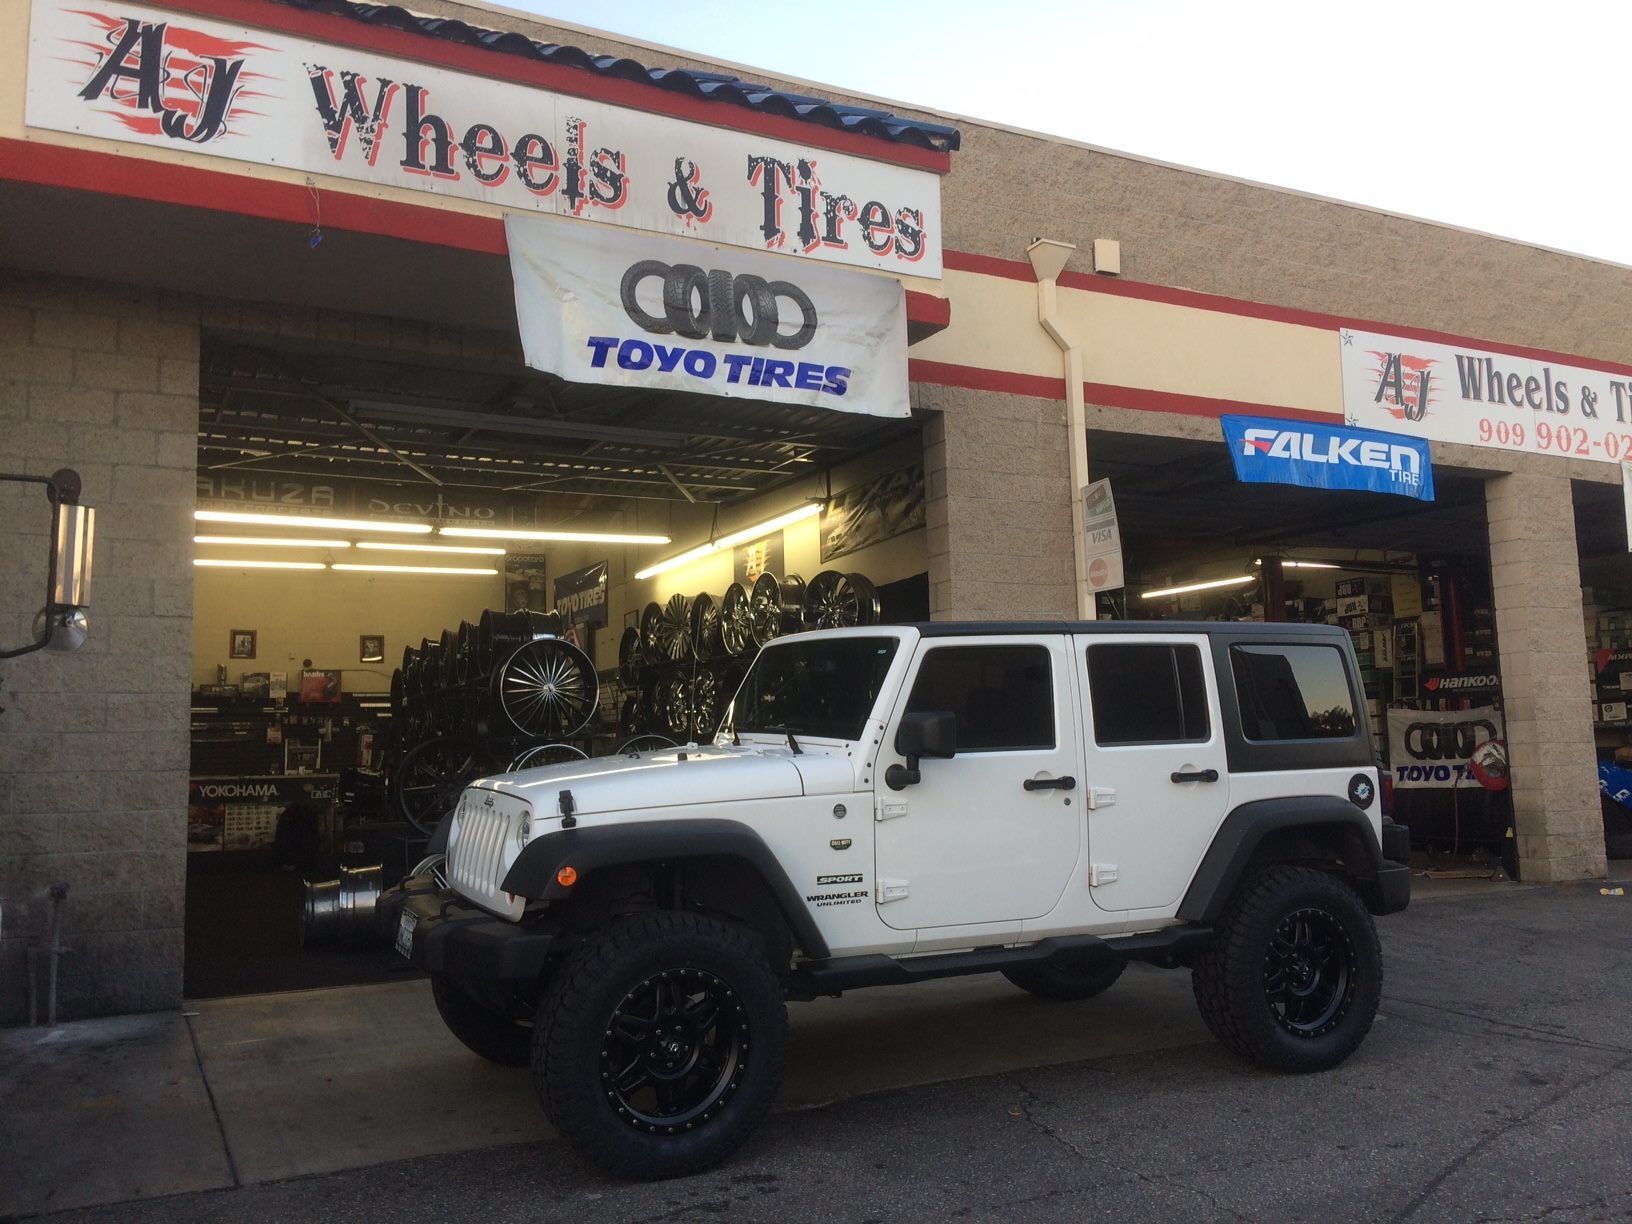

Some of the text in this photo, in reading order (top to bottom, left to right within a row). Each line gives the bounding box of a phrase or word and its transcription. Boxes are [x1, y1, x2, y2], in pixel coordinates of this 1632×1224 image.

[302, 62, 629, 213] Wheels
[667, 156, 712, 227] &
[747, 154, 926, 261] Tires
[587, 336, 851, 397] TOYO TIRES
[1455, 354, 1570, 415] Wheels
[1581, 385, 1599, 419] &
[1479, 418, 1525, 446] 909
[1242, 428, 1420, 472] FALKEN
[1389, 469, 1419, 487] TIRE
[1092, 528, 1112, 544] VISA
[556, 593, 578, 616] TOYO
[1396, 765, 1450, 782] TOYO
[199, 784, 279, 797] YOKOHAMA
[819, 875, 862, 884] SPORT
[806, 891, 868, 902] WRANGLER
[817, 899, 861, 907] UNLIMITED
